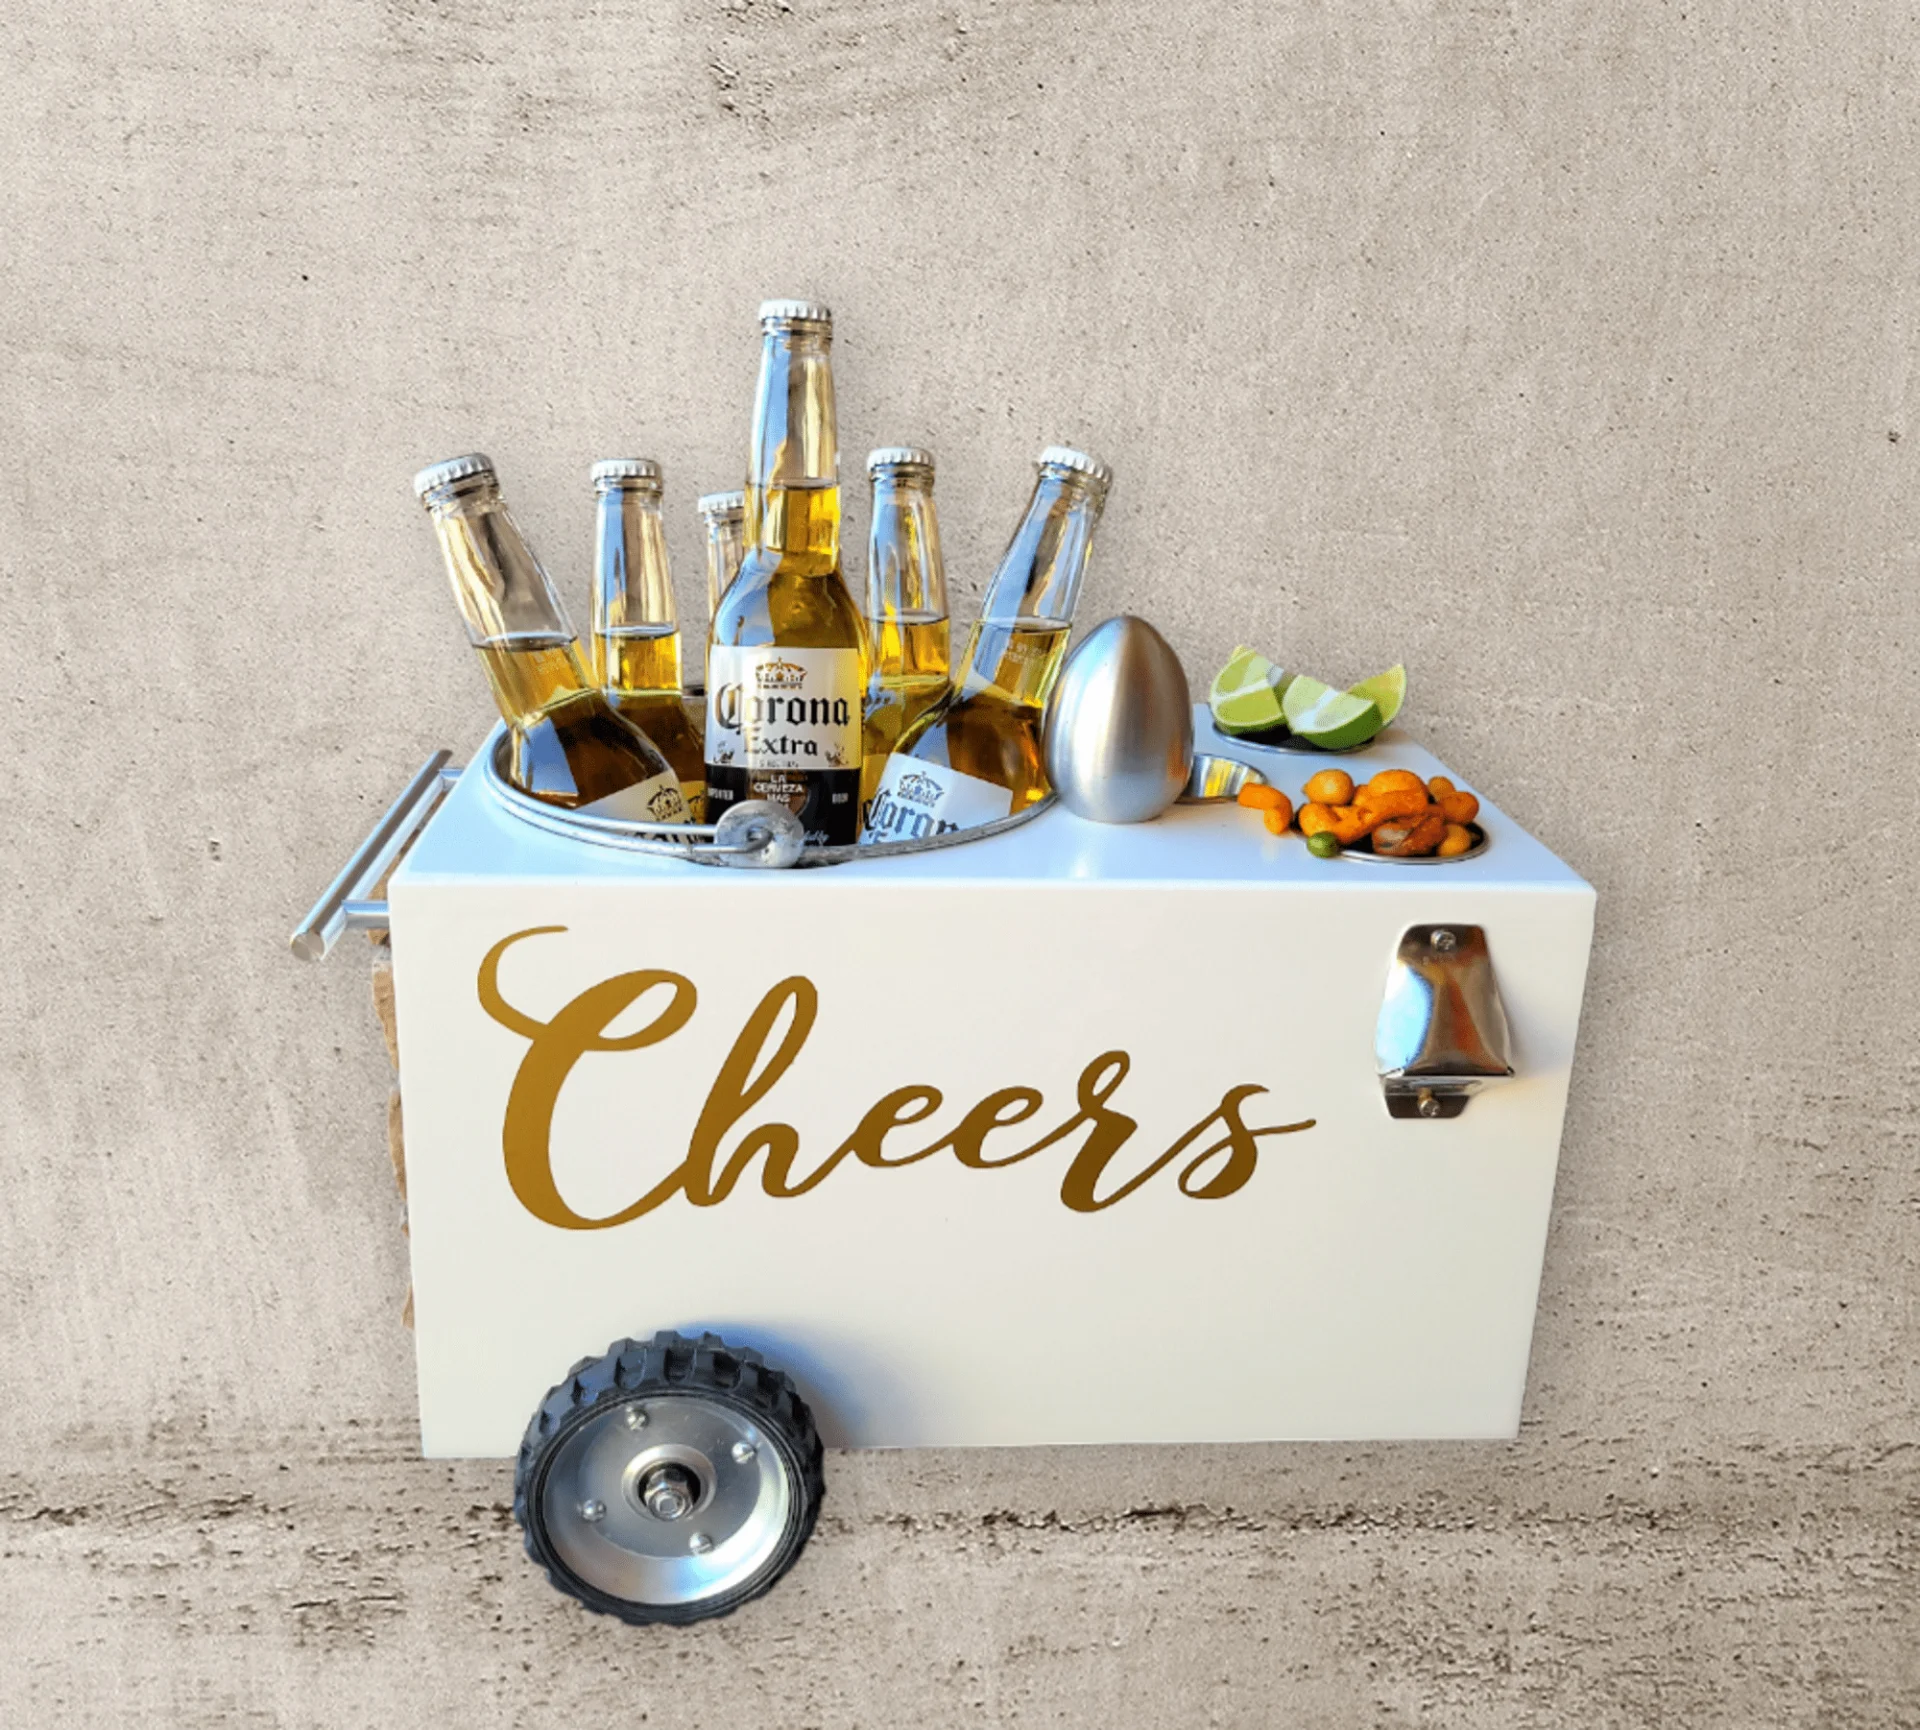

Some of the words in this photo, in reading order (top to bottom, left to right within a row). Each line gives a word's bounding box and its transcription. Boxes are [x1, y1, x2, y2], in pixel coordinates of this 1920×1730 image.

[715, 683, 850, 735] Corona
[744, 727, 818, 755] Extra
[753, 783, 803, 794] CERVEZA
[770, 775, 786, 783] LA
[478, 927, 1316, 1230] Cheers
